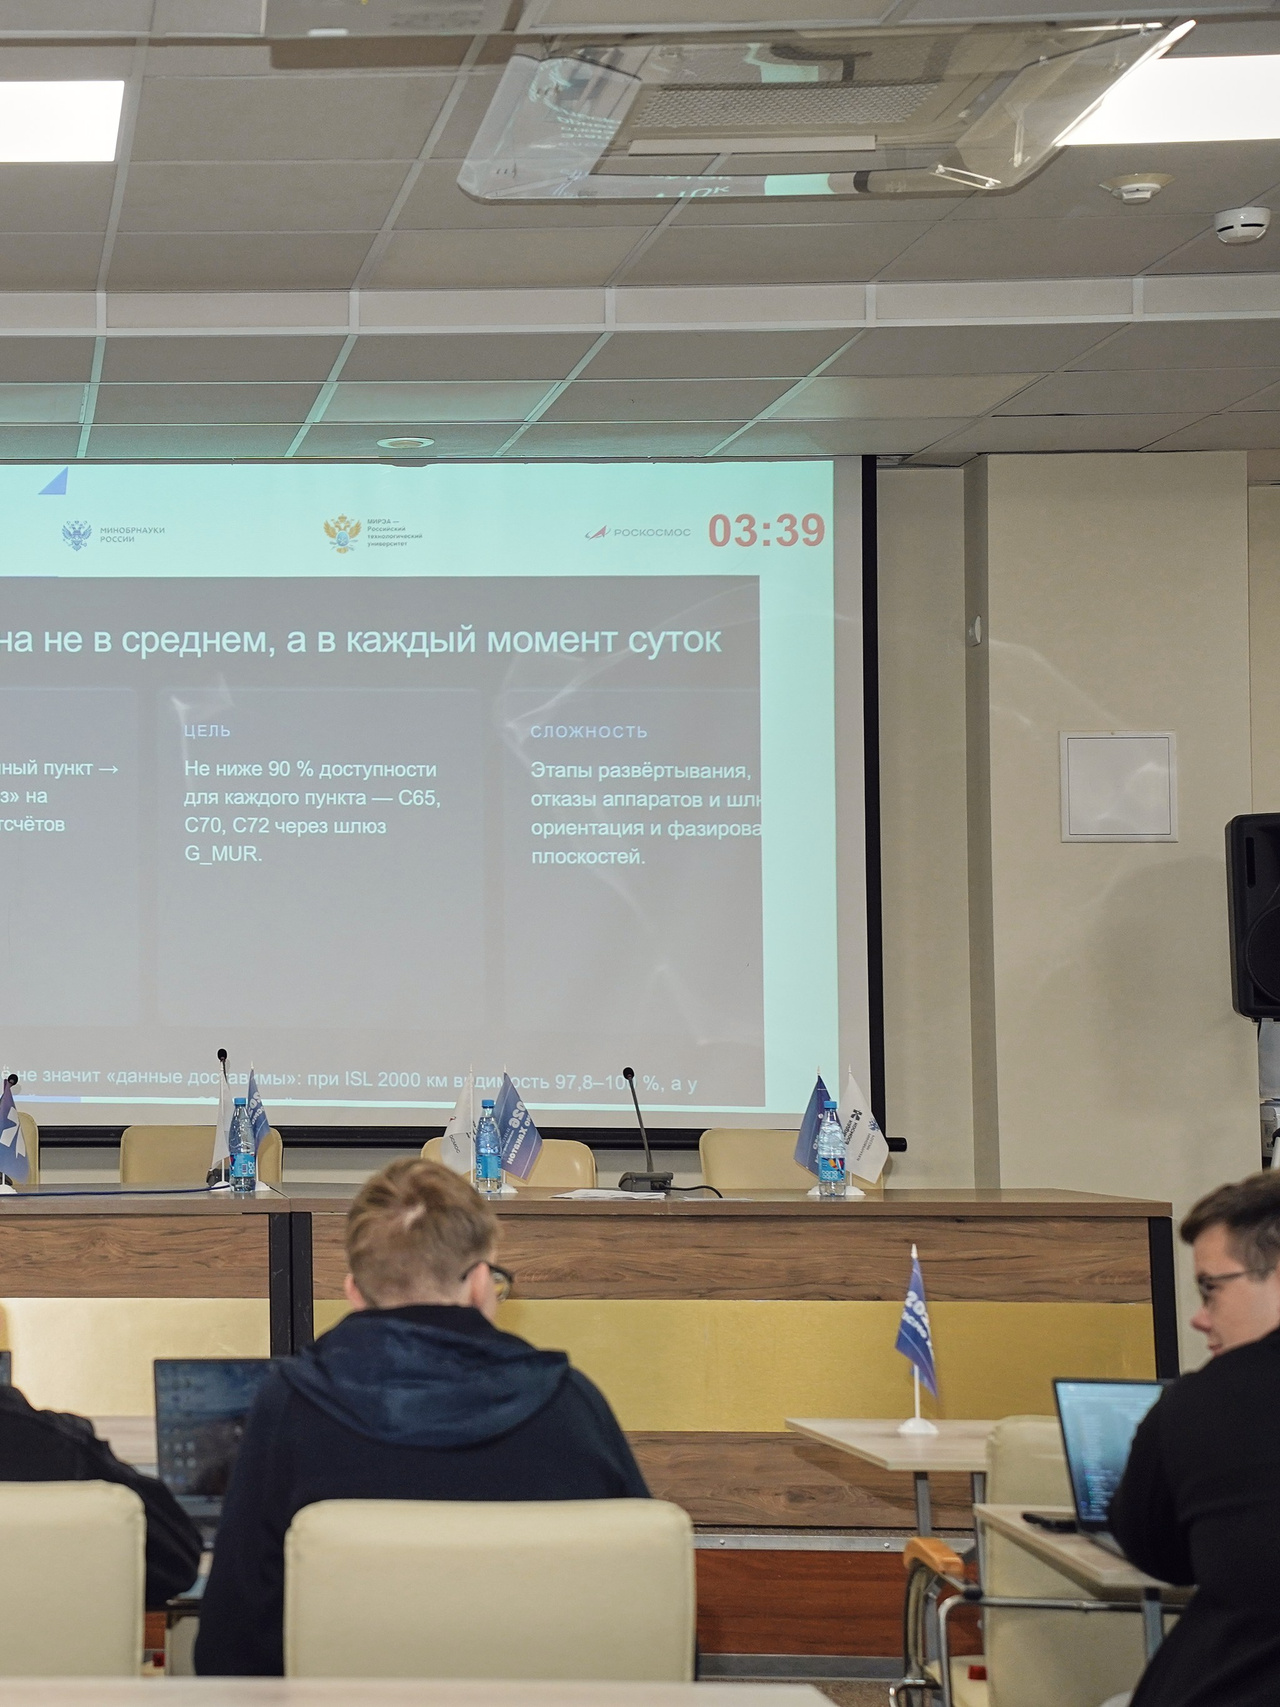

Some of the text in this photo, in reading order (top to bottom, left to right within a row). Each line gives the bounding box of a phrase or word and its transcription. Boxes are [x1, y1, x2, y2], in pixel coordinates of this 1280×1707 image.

[99, 526, 166, 535] МИНОБРНАУКИ
[99, 535, 135, 543] РОССИИ
[613, 527, 692, 538] РОСКОСМОС
[708, 512, 826, 548] 03:39
[44, 630, 83, 653] не
[94, 631, 112, 653] в
[122, 631, 276, 660] среднем,
[286, 631, 308, 653] а
[318, 631, 336, 653] в
[347, 624, 476, 658] каждый
[487, 630, 619, 653] момент
[628, 630, 722, 661] суток
[184, 724, 231, 740] ЦЕЛЬ
[530, 724, 648, 739] СЛОЖНОСТЬ
[43, 762, 94, 780] пункт
[184, 759, 437, 781] Не ниже 90 % доступности
[530, 759, 751, 782] Этапы развёртывания,
[26, 790, 48, 804] на
[183, 792, 219, 808] для
[224, 792, 300, 808] каждого
[305, 792, 367, 810] пункта
[530, 793, 597, 808] отказы
[602, 793, 703, 811] аппаратов
[709, 795, 721, 808] и
[274, 821, 329, 838] через
[333, 821, 387, 834] шлюз
[531, 822, 645, 840] ориентация
[650, 823, 662, 836] и
[184, 844, 263, 866] G_MUR.
[531, 847, 646, 865] плоскостей.
[17, 1070, 38, 1082] не
[42, 1069, 102, 1083] значит
[106, 1070, 183, 1086] «данные
[187, 1071, 302, 1086] досавмы»:
[307, 1073, 339, 1089] при
[345, 1070, 374, 1087] ISL
[378, 1070, 421, 1088] 2000
[426, 1075, 448, 1088] км
[642, 1074, 665, 1092] %,
[670, 1078, 682, 1091] а
[687, 1079, 698, 1095] у
